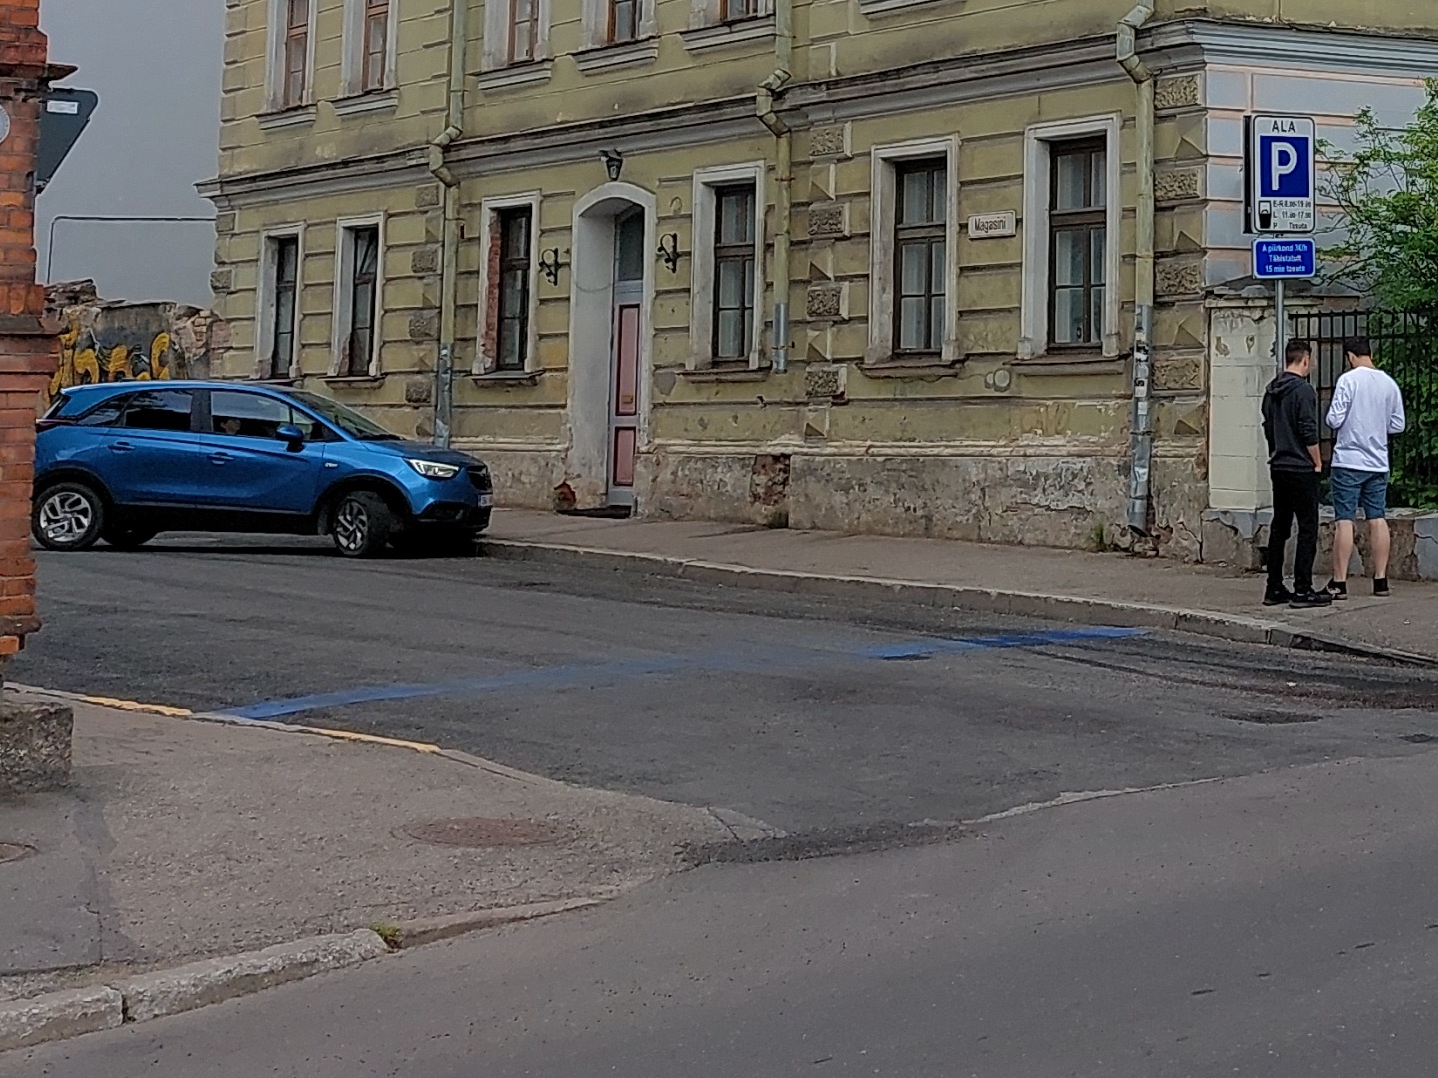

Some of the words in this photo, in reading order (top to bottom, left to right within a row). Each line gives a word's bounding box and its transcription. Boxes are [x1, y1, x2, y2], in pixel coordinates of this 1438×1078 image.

[1271, 120, 1296, 133] ALA
[1271, 141, 1298, 191] P
[974, 216, 1006, 233] Magasini
[1265, 264, 1273, 273] 15
